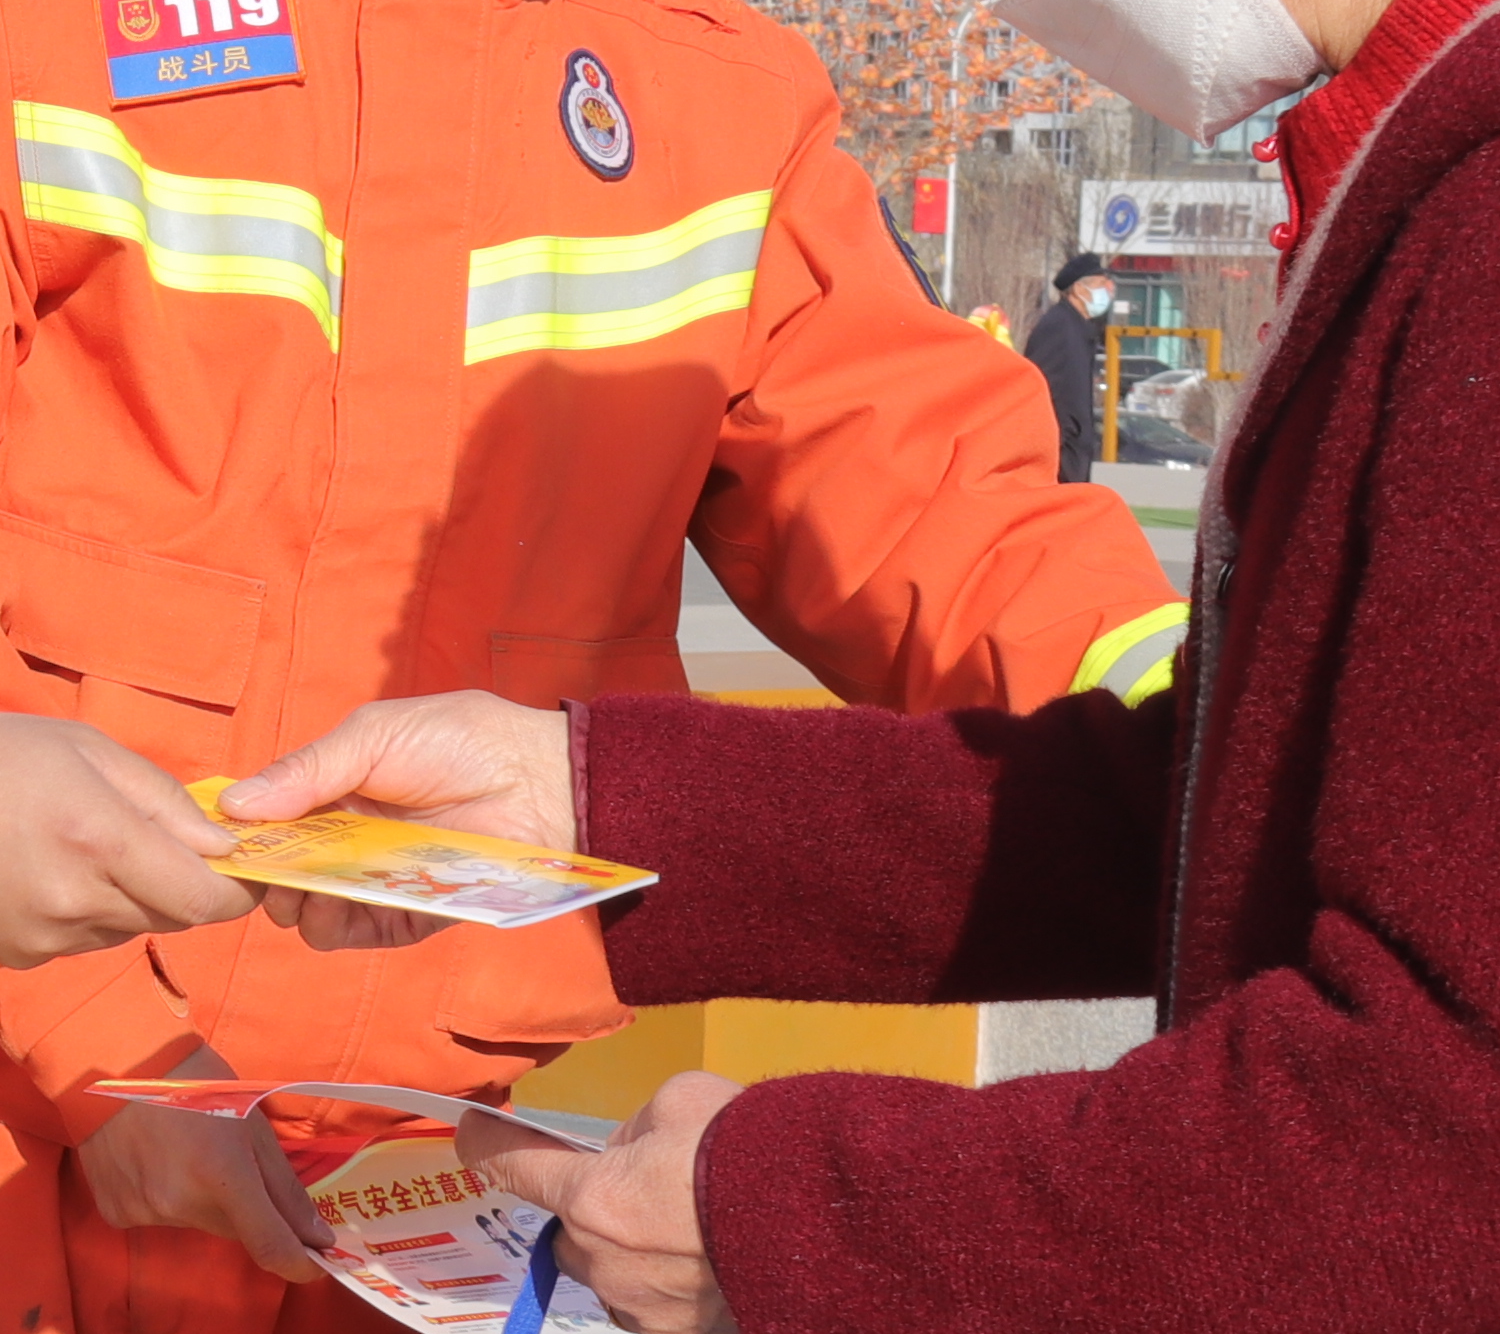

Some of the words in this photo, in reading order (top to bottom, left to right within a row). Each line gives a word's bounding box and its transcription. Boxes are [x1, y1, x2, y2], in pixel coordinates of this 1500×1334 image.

[157, 46, 251, 82] 战斗员
[226, 817, 357, 862] 火知识普及
[313, 1167, 505, 1226] 燃气安全注意事
